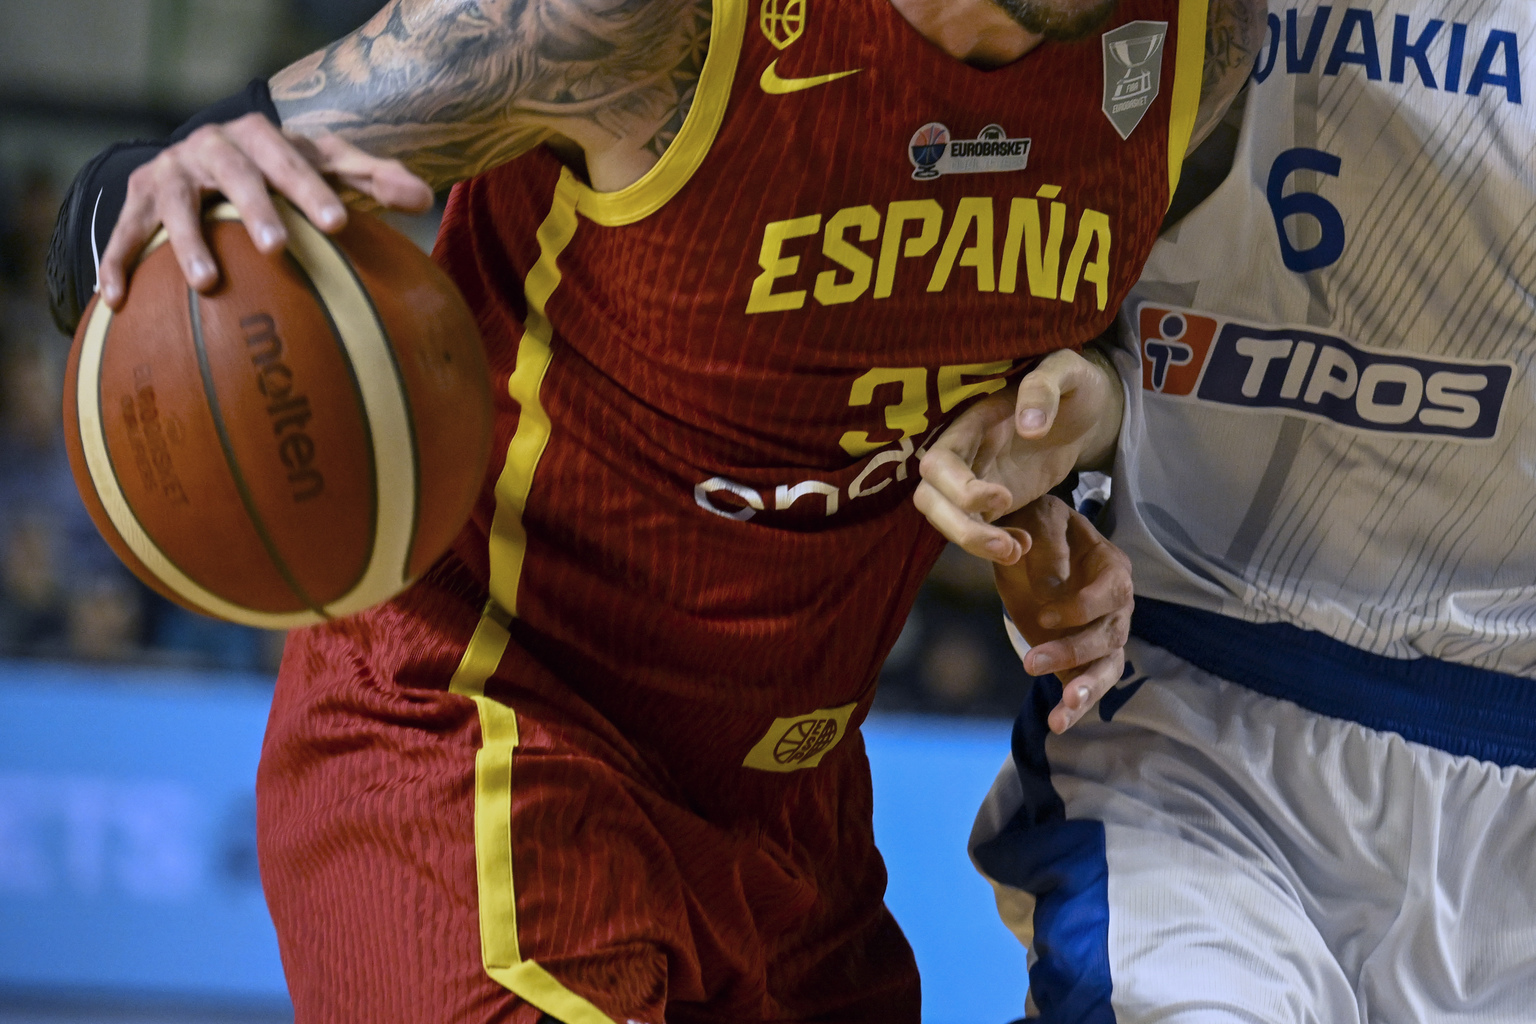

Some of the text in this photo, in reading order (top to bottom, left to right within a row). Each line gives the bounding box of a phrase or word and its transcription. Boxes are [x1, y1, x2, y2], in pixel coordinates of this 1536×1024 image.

[1252, 6, 1522, 105] OVAKIA
[950, 141, 1029, 157] EUROBASKET
[745, 184, 1110, 314] ESPAÑA
[1266, 147, 1345, 273] 6
[240, 311, 325, 504] molten
[1235, 336, 1488, 427] TIPOS
